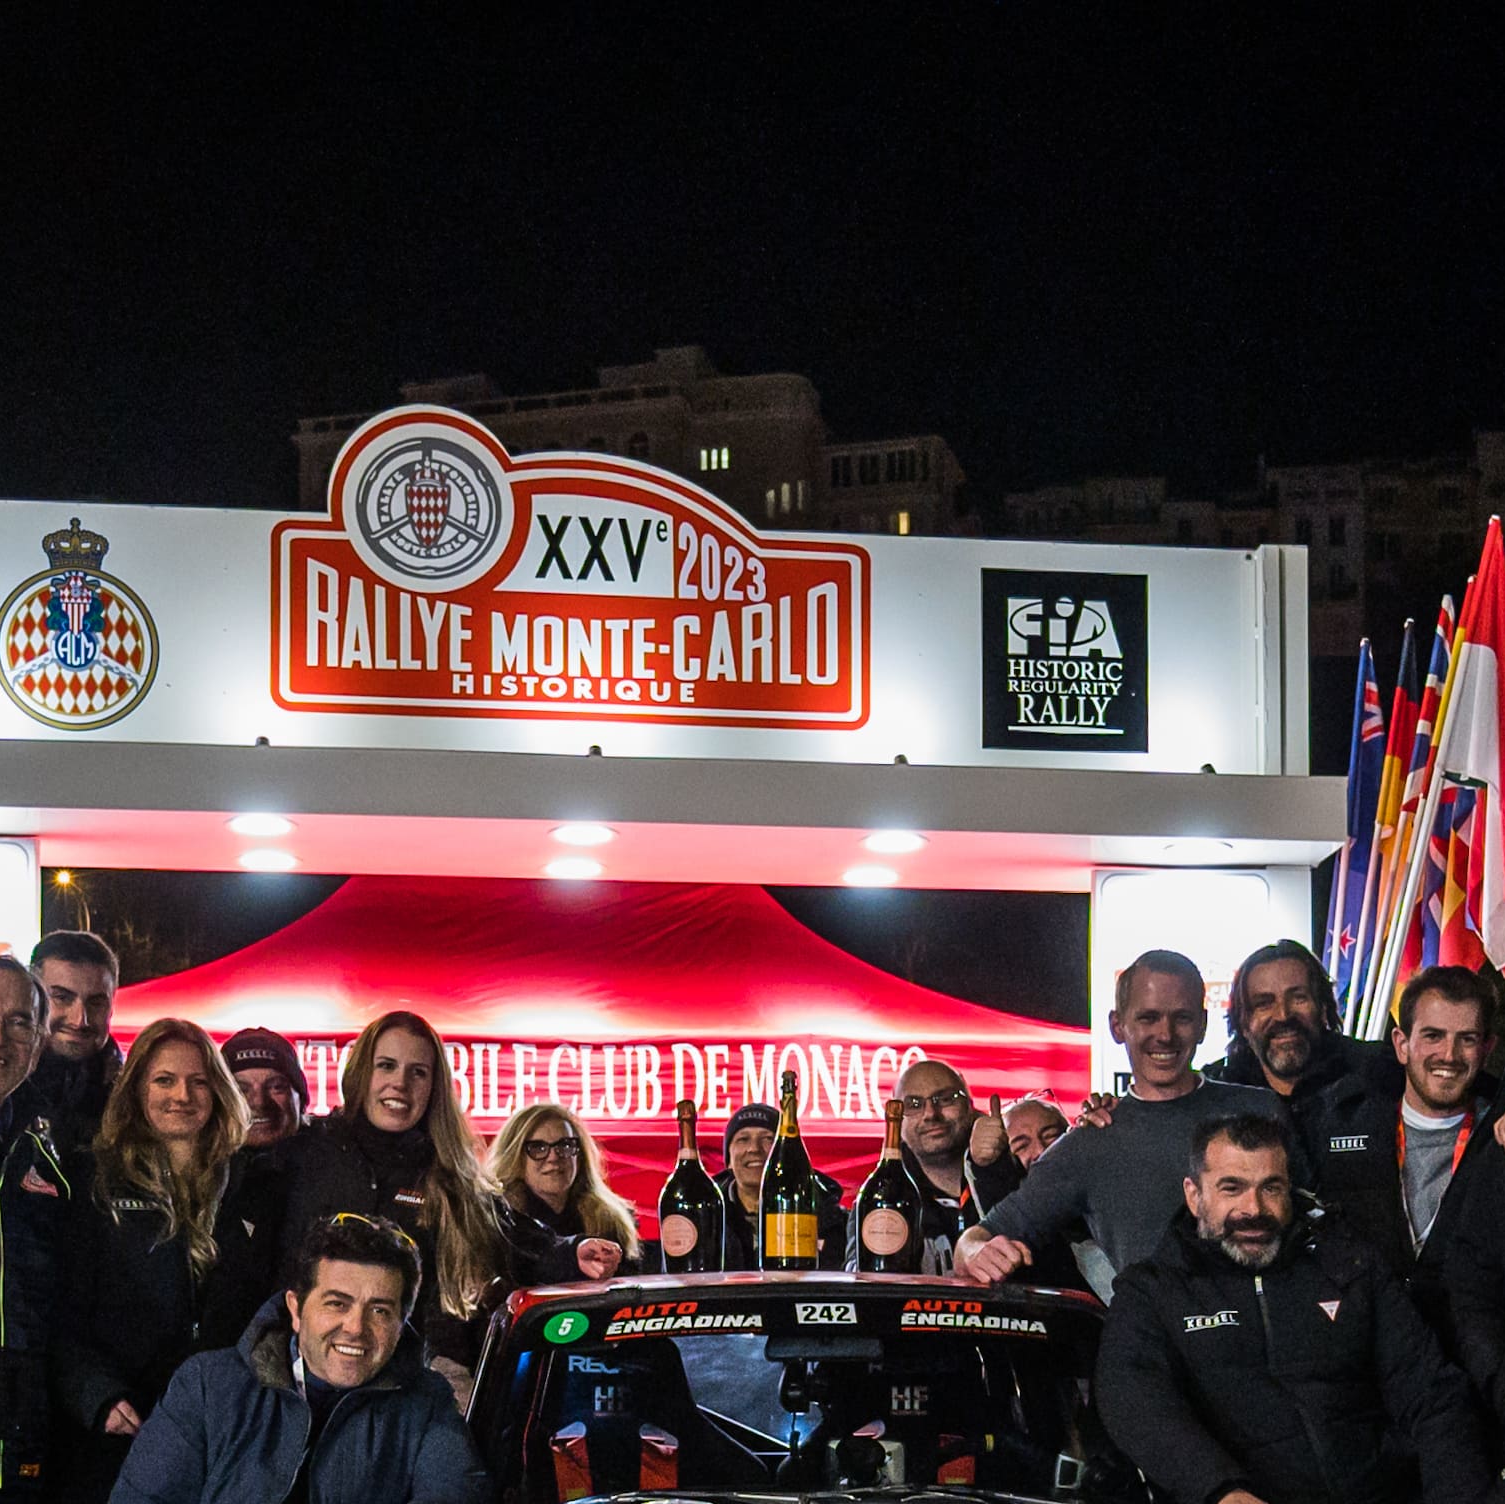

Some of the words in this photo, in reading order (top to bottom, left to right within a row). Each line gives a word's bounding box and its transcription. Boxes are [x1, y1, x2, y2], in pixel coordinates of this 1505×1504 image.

[678, 522, 767, 602] 2023
[306, 557, 472, 672] RALLYE
[492, 581, 839, 686] MONTE-CARLO
[1007, 659, 1123, 681] HISTORIC
[453, 673, 695, 704] HISTORIQUE
[1007, 679, 1122, 696] REGULARITY
[1017, 694, 1111, 726] RALLY
[548, 1043, 662, 1119] CLUB
[672, 1043, 732, 1118] DE
[741, 1044, 927, 1119] MONAC
[612, 1302, 698, 1320] AUTO
[802, 1305, 851, 1322] 242
[903, 1299, 983, 1313] AUTO
[558, 1318, 574, 1336] 5
[605, 1314, 763, 1335] ENGIADINA
[901, 1313, 1047, 1333] ENGIADINA
